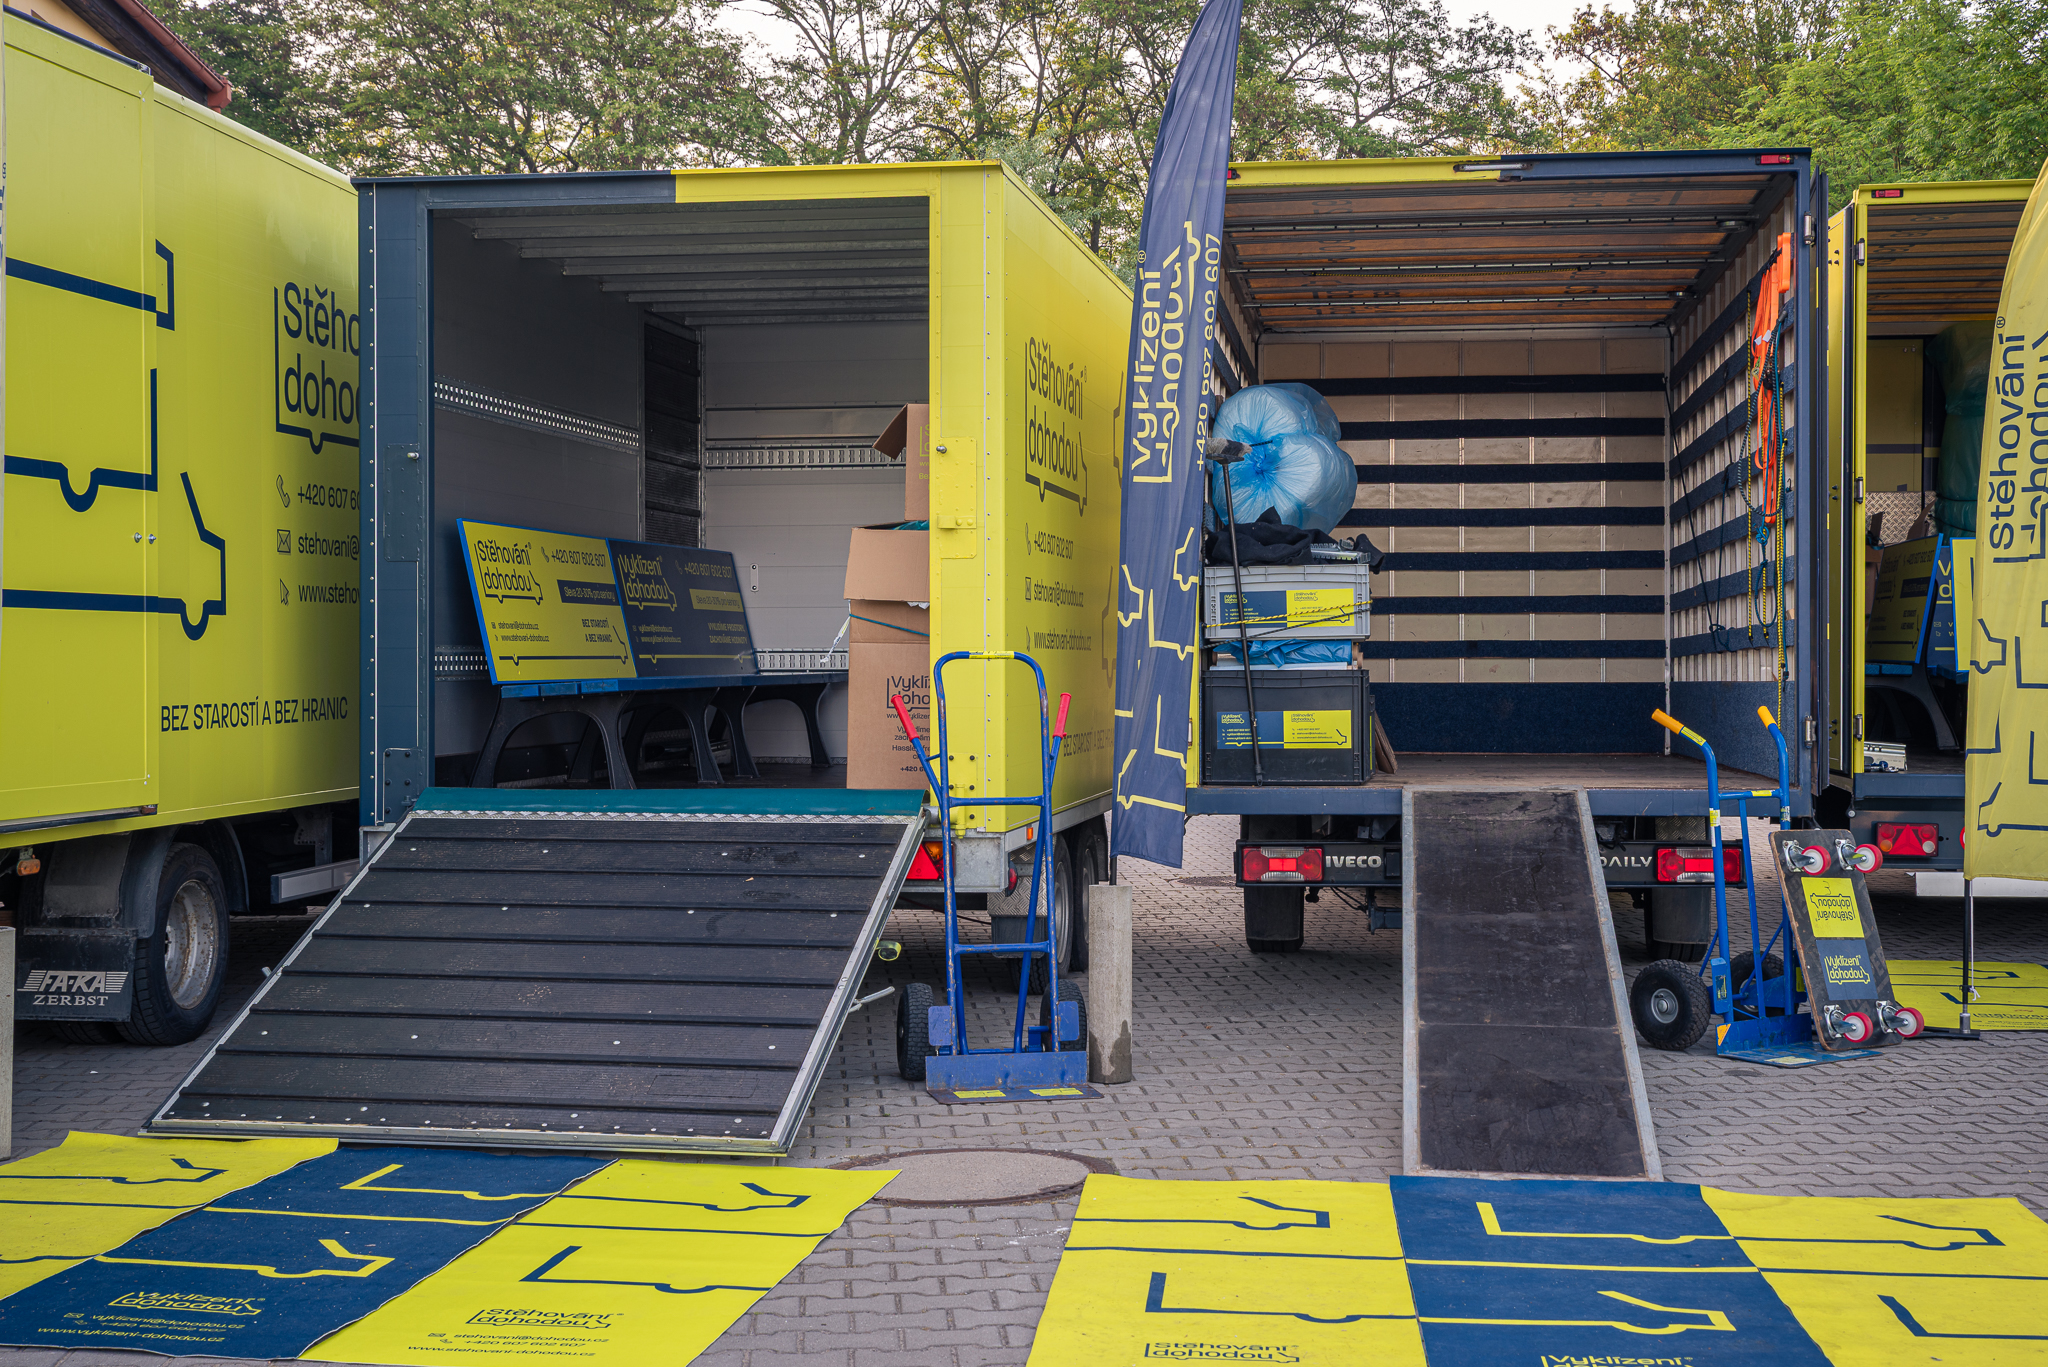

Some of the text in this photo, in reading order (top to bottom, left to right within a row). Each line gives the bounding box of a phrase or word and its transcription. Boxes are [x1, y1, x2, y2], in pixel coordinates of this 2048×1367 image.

[1196, 234, 1220, 471] +420 607 602 607
[284, 353, 359, 425] doho
[1029, 405, 1078, 482] dohodou
[298, 484, 325, 506] +420
[328, 486, 348, 508] 607
[1034, 531, 1046, 553] +420
[552, 549, 606, 567] +420 607 602 607
[685, 562, 699, 575] +420
[700, 564, 710, 576] 607
[484, 566, 532, 592] dohodou
[627, 578, 669, 600] dohodou
[161, 696, 348, 732] BEZ STAROSTÍ A BEZ HRANIC
[1325, 856, 1382, 868] IVECO
[1818, 899, 1850, 909] dohodou
[1830, 968, 1864, 979] dohodou
[33, 995, 108, 1006] ZERBST
[122, 1298, 242, 1311] dohodou
[92, 1314, 246, 1328] vyklizeni@dohodou.cz
[476, 1316, 589, 1326] dohodou
[38, 1327, 226, 1342] www.vyklizeni-dohodou.cz
[454, 1334, 609, 1342] stehovani@dohodou.cz
[408, 1346, 596, 1356] www.stehovani-dohodou.cz
[1152, 1349, 1273, 1359] dohodou
